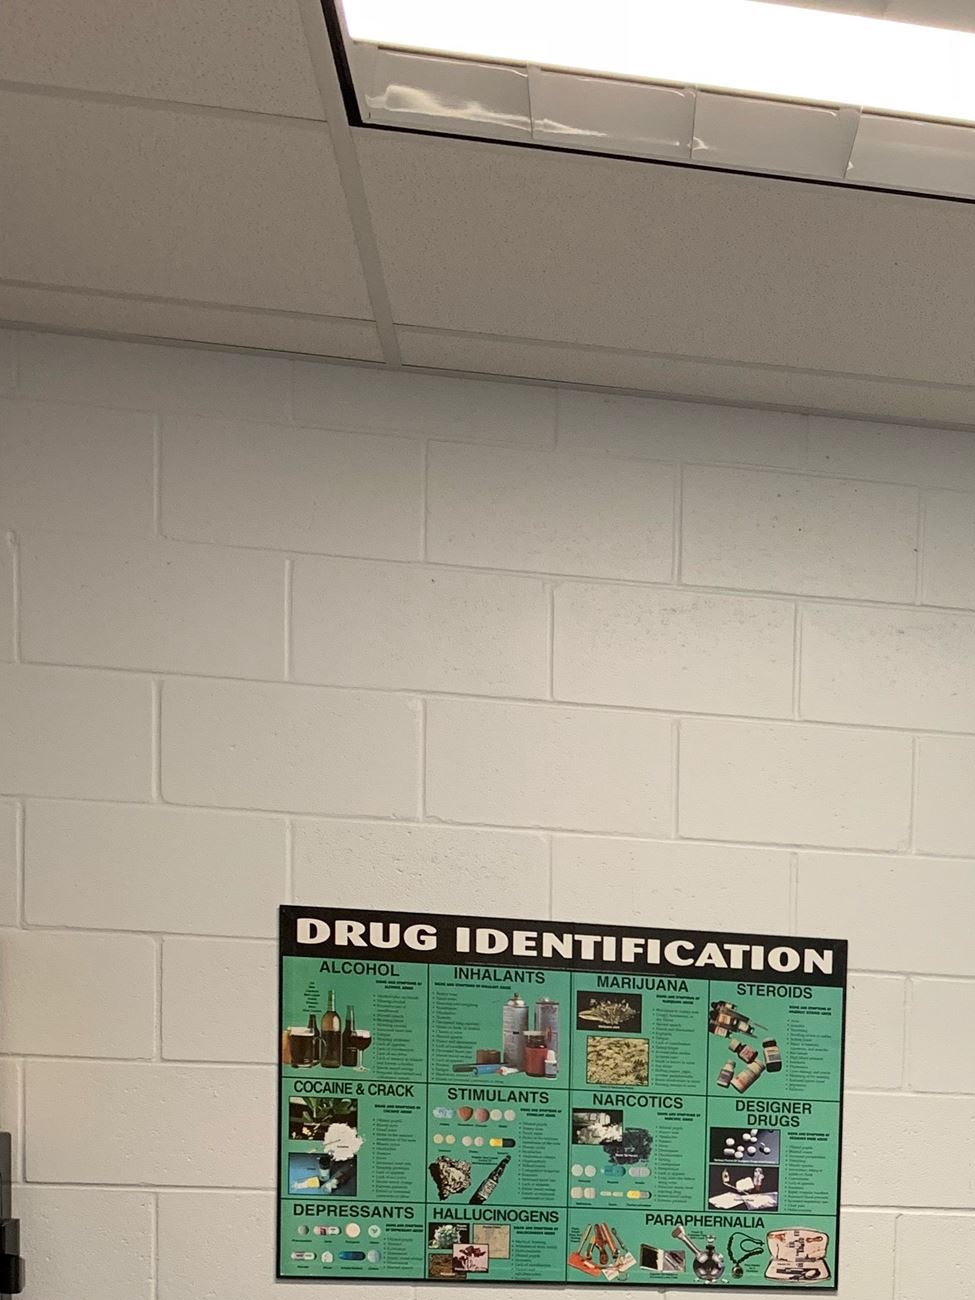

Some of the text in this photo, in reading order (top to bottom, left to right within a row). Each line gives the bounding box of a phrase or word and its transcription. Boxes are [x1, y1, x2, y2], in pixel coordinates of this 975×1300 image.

[296, 917, 833, 974] DRUG IDENTIFICATION
[320, 961, 399, 977] ALCOHOL
[454, 967, 546, 984] INHALANTS
[597, 975, 689, 992] MARIJUANA
[736, 983, 813, 999] STEROIDS
[294, 1080, 414, 1097] COCAINE & CRACK
[447, 1087, 549, 1104] STIMULANTS
[592, 1094, 683, 1109] NARCOTICS
[735, 1100, 812, 1115] DESIGNER
[747, 1114, 800, 1127] DRUGS
[293, 1204, 414, 1219] DEPRESSANTS
[433, 1207, 559, 1223] HALLUCINOGENS
[645, 1213, 765, 1229] PARAPHERNALIA
